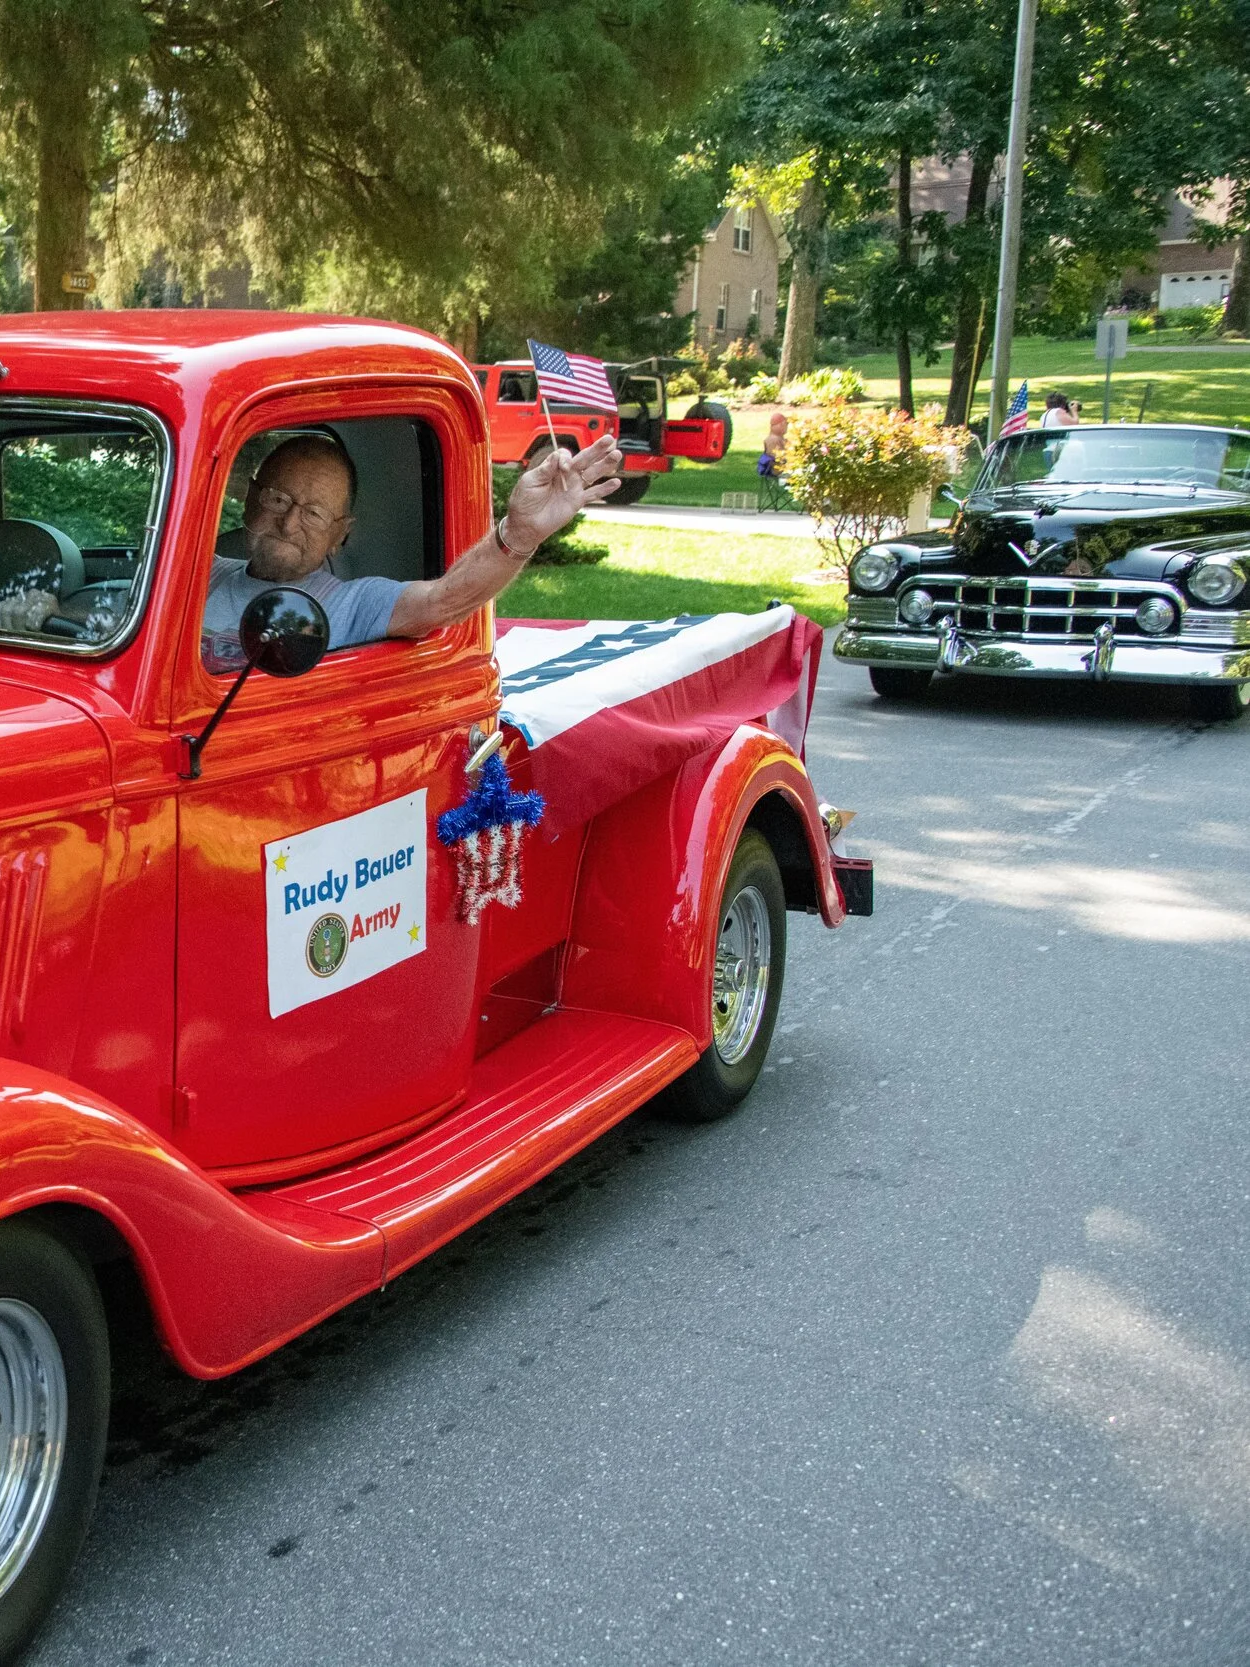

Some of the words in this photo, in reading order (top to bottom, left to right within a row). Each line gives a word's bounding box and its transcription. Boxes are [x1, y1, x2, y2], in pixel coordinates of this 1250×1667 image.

[284, 869, 349, 915] Rudy
[355, 845, 415, 890] Bauer
[310, 919, 328, 947] UNITED
[328, 917, 345, 938] STATES
[350, 902, 401, 943] Army
[319, 962, 336, 973] ARMY
